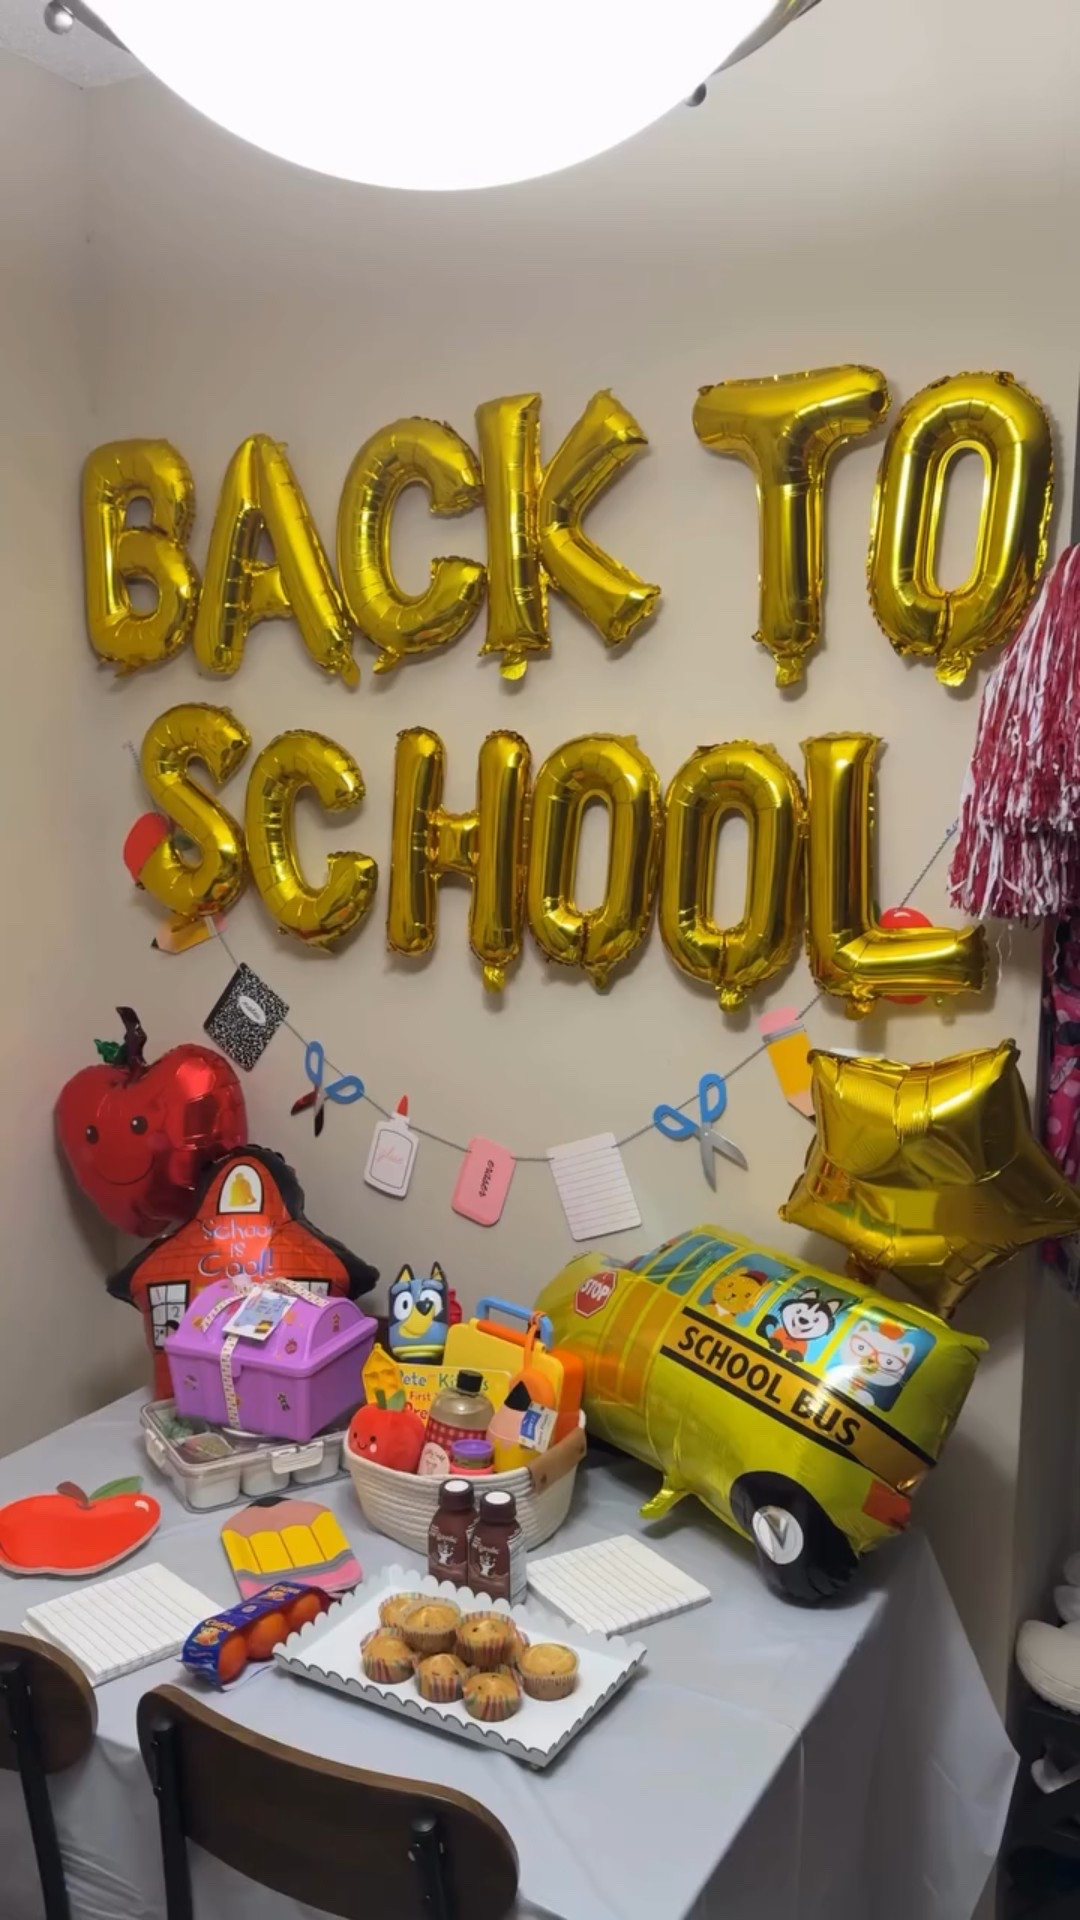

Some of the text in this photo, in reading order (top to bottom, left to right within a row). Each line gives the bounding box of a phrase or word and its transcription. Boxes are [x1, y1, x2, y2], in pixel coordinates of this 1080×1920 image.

[82, 364, 1056, 690] BACK TO
[140, 703, 990, 1018] SCHOOL
[580, 1278, 610, 1302] STOP
[677, 1326, 862, 1447] SCHOOL BUS
